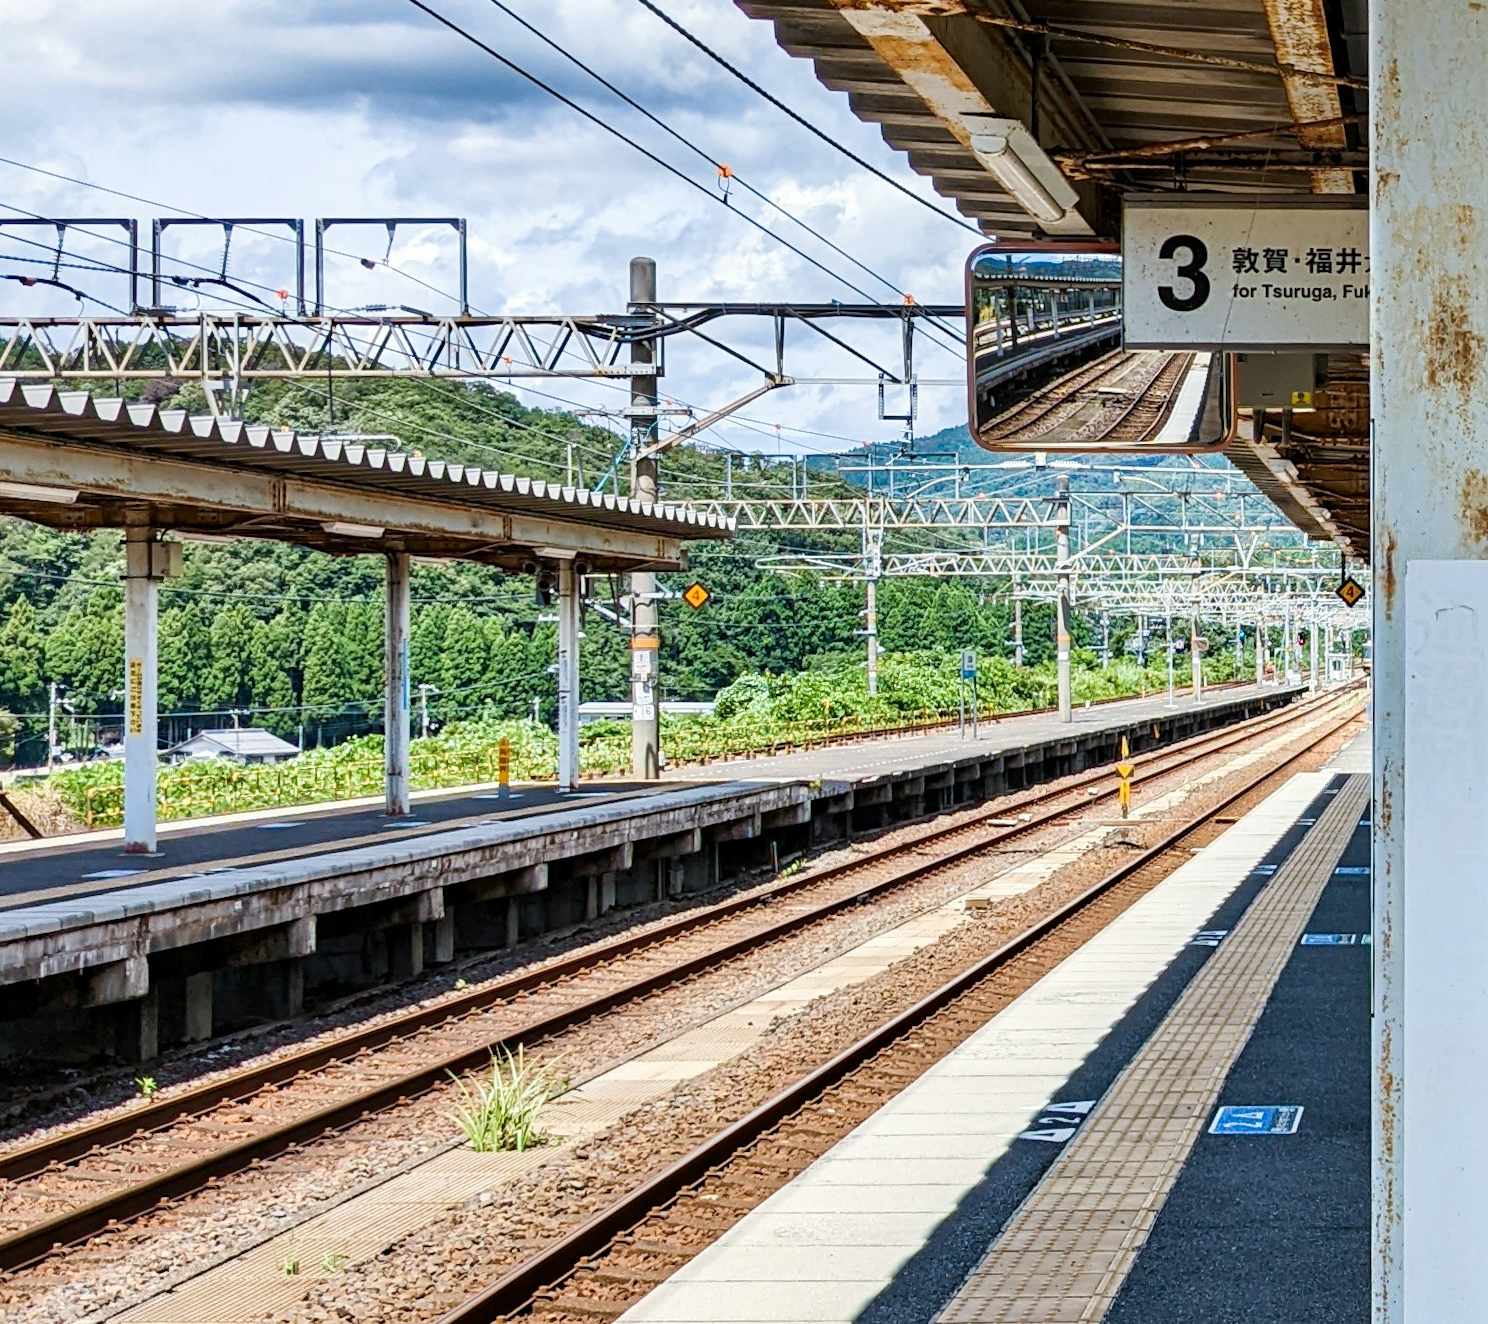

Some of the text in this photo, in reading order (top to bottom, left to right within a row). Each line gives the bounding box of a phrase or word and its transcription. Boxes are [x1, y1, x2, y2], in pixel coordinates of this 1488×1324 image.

[1156, 235, 1210, 311] 3
[1232, 248, 1370, 274] 敦賀・福井
[1233, 285, 1257, 298] for
[1262, 285, 1337, 301] Tsuruga,
